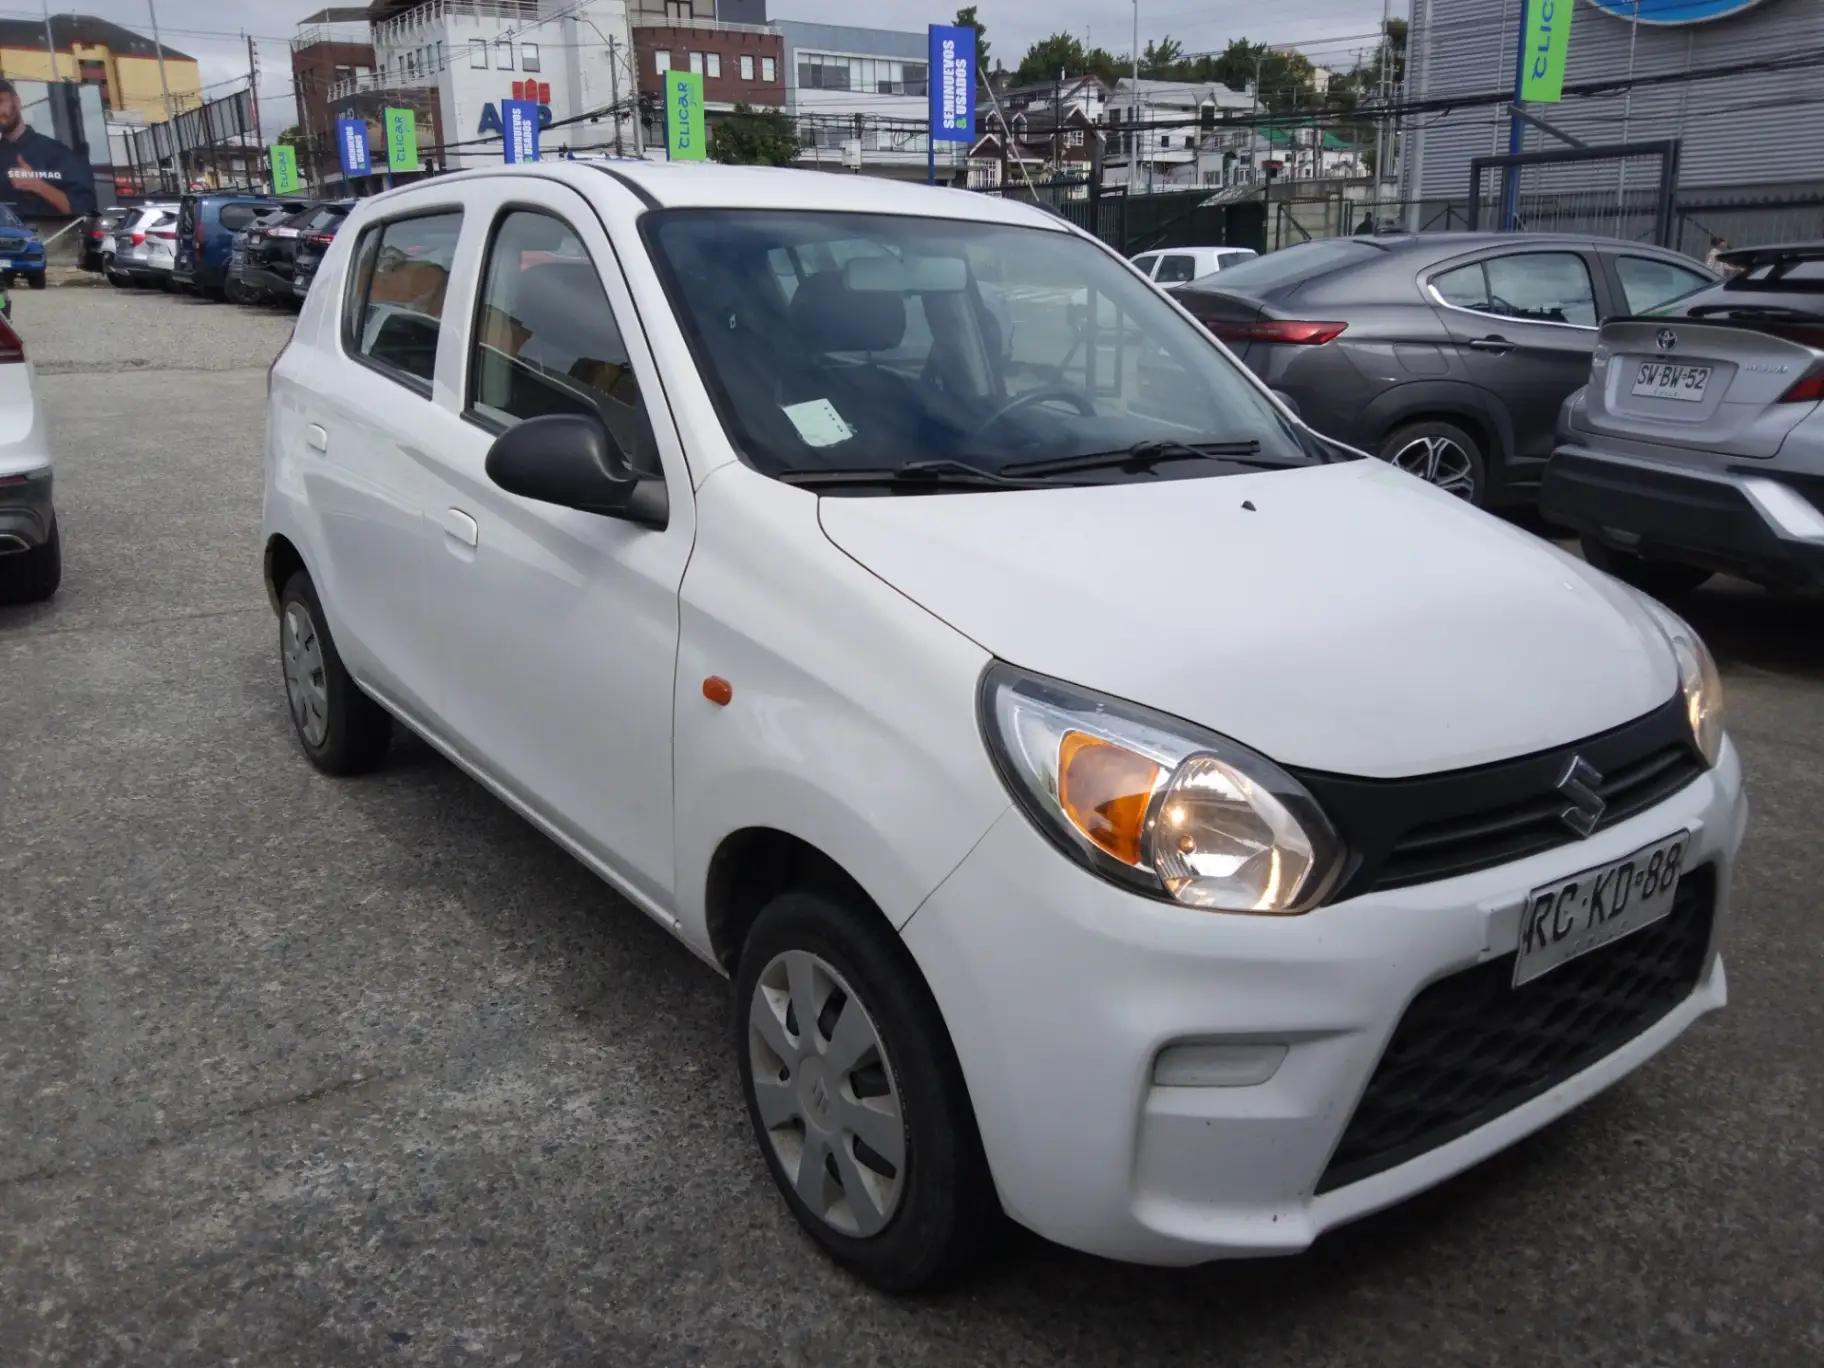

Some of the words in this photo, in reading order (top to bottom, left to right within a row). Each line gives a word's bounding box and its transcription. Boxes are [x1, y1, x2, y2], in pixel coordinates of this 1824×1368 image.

[943, 40, 955, 129] SEMINUEVOS
[956, 59, 967, 115] USADOS
[523, 120, 533, 155] USADOS
[8, 170, 62, 179] SERVIMAQ
